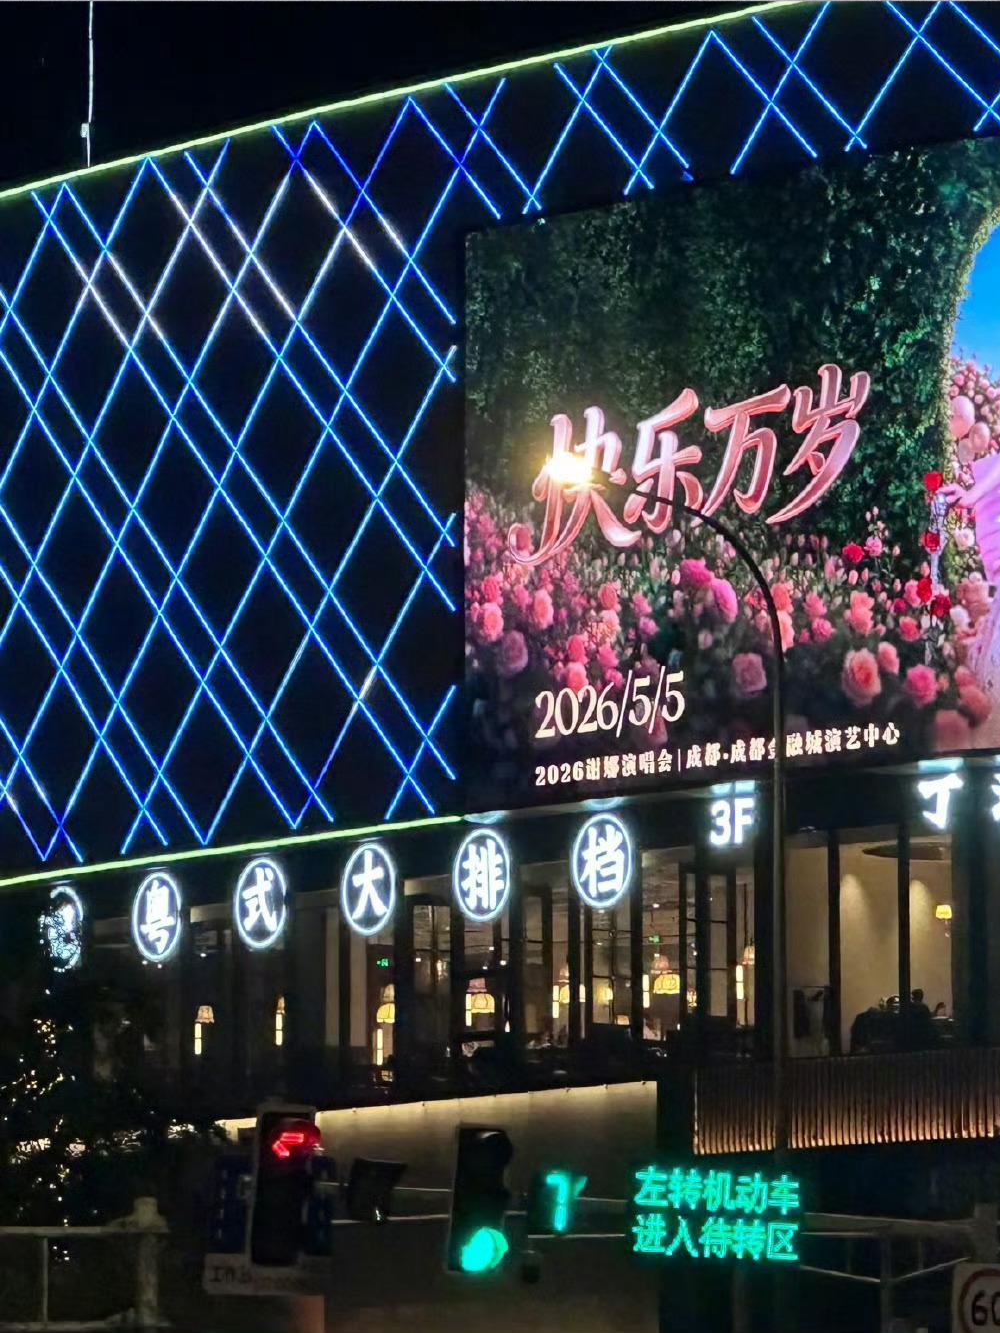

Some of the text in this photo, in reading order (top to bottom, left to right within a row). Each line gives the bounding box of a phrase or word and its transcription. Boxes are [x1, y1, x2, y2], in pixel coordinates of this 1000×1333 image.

[507, 363, 871, 566] 快乐万岁
[534, 665, 686, 741] 2026/5/5
[45, 799, 756, 962] 粤式大排档 3F
[633, 1165, 800, 1216] 左转机动车
[631, 1213, 799, 1261] 进入待转区
